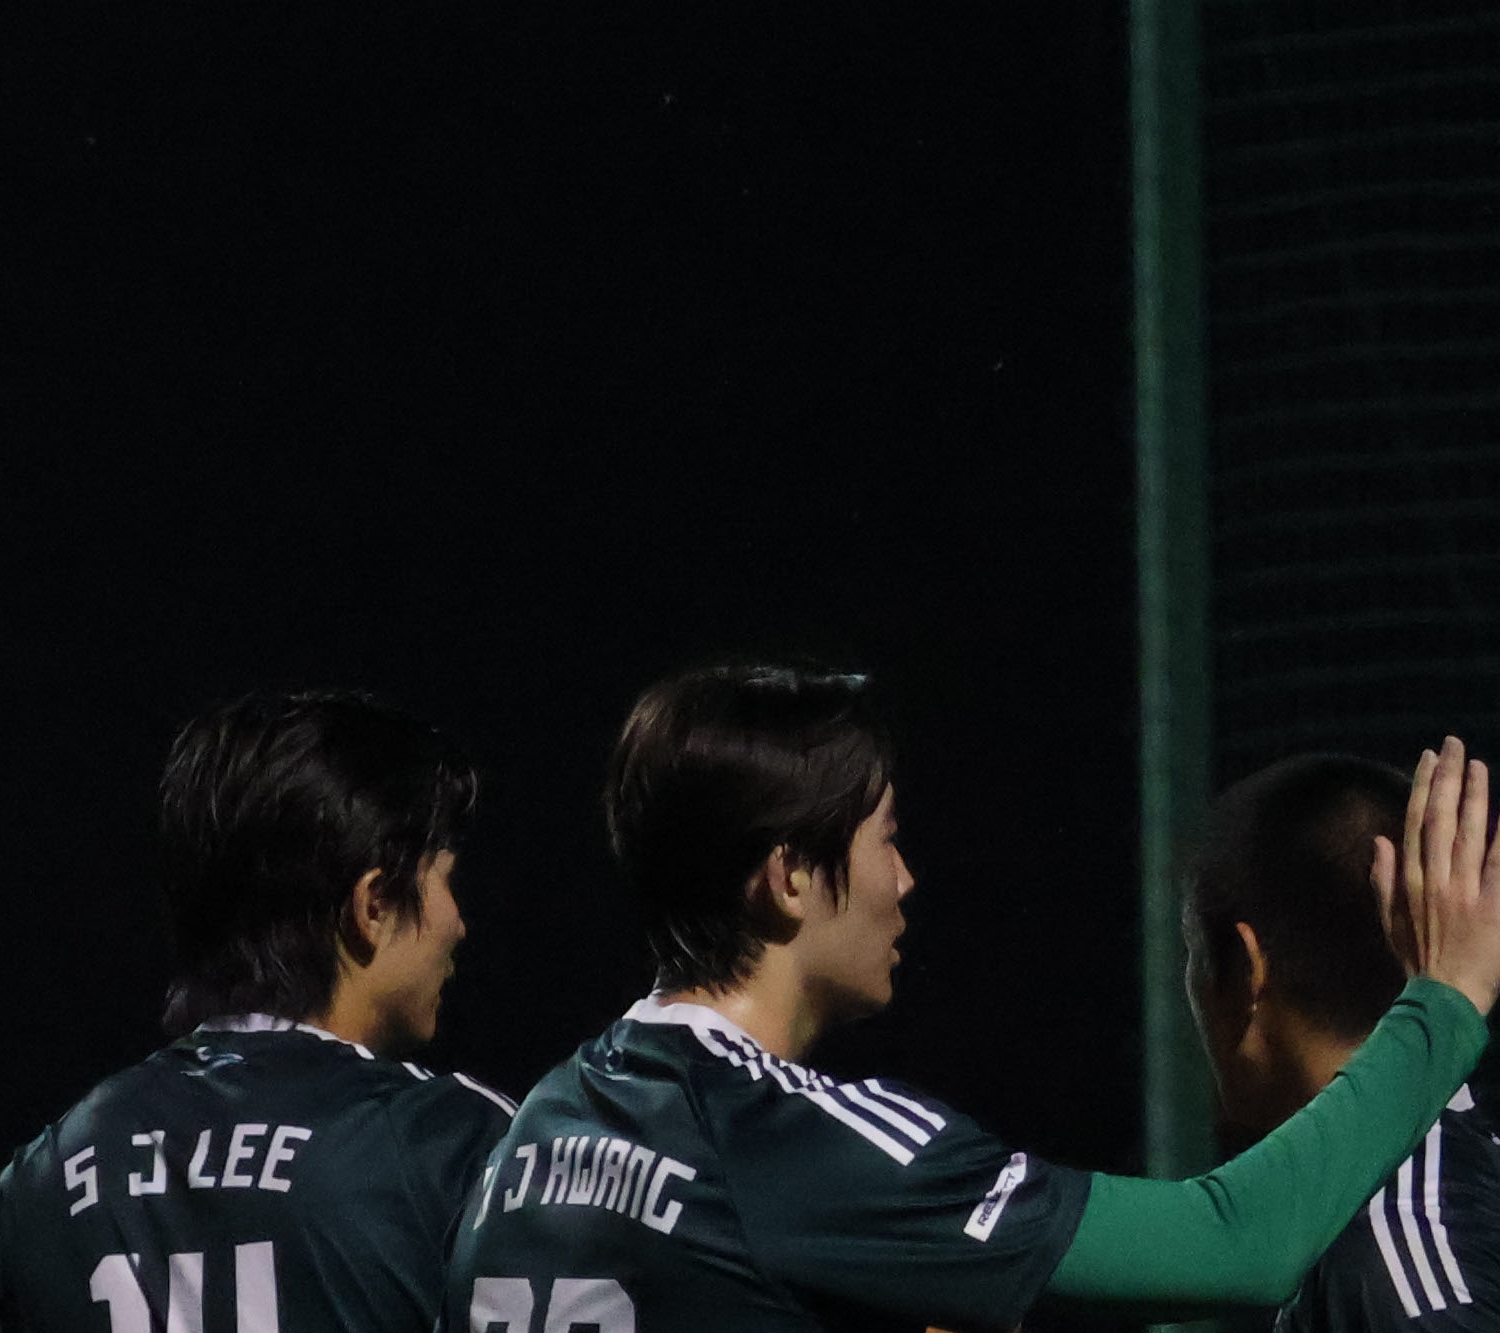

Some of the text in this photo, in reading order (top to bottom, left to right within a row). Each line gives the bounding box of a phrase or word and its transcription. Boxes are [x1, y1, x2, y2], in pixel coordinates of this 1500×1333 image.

[64, 1123, 313, 1217] S J LEE
[503, 1143, 538, 1213] J
[540, 1136, 698, 1235] HWANG
